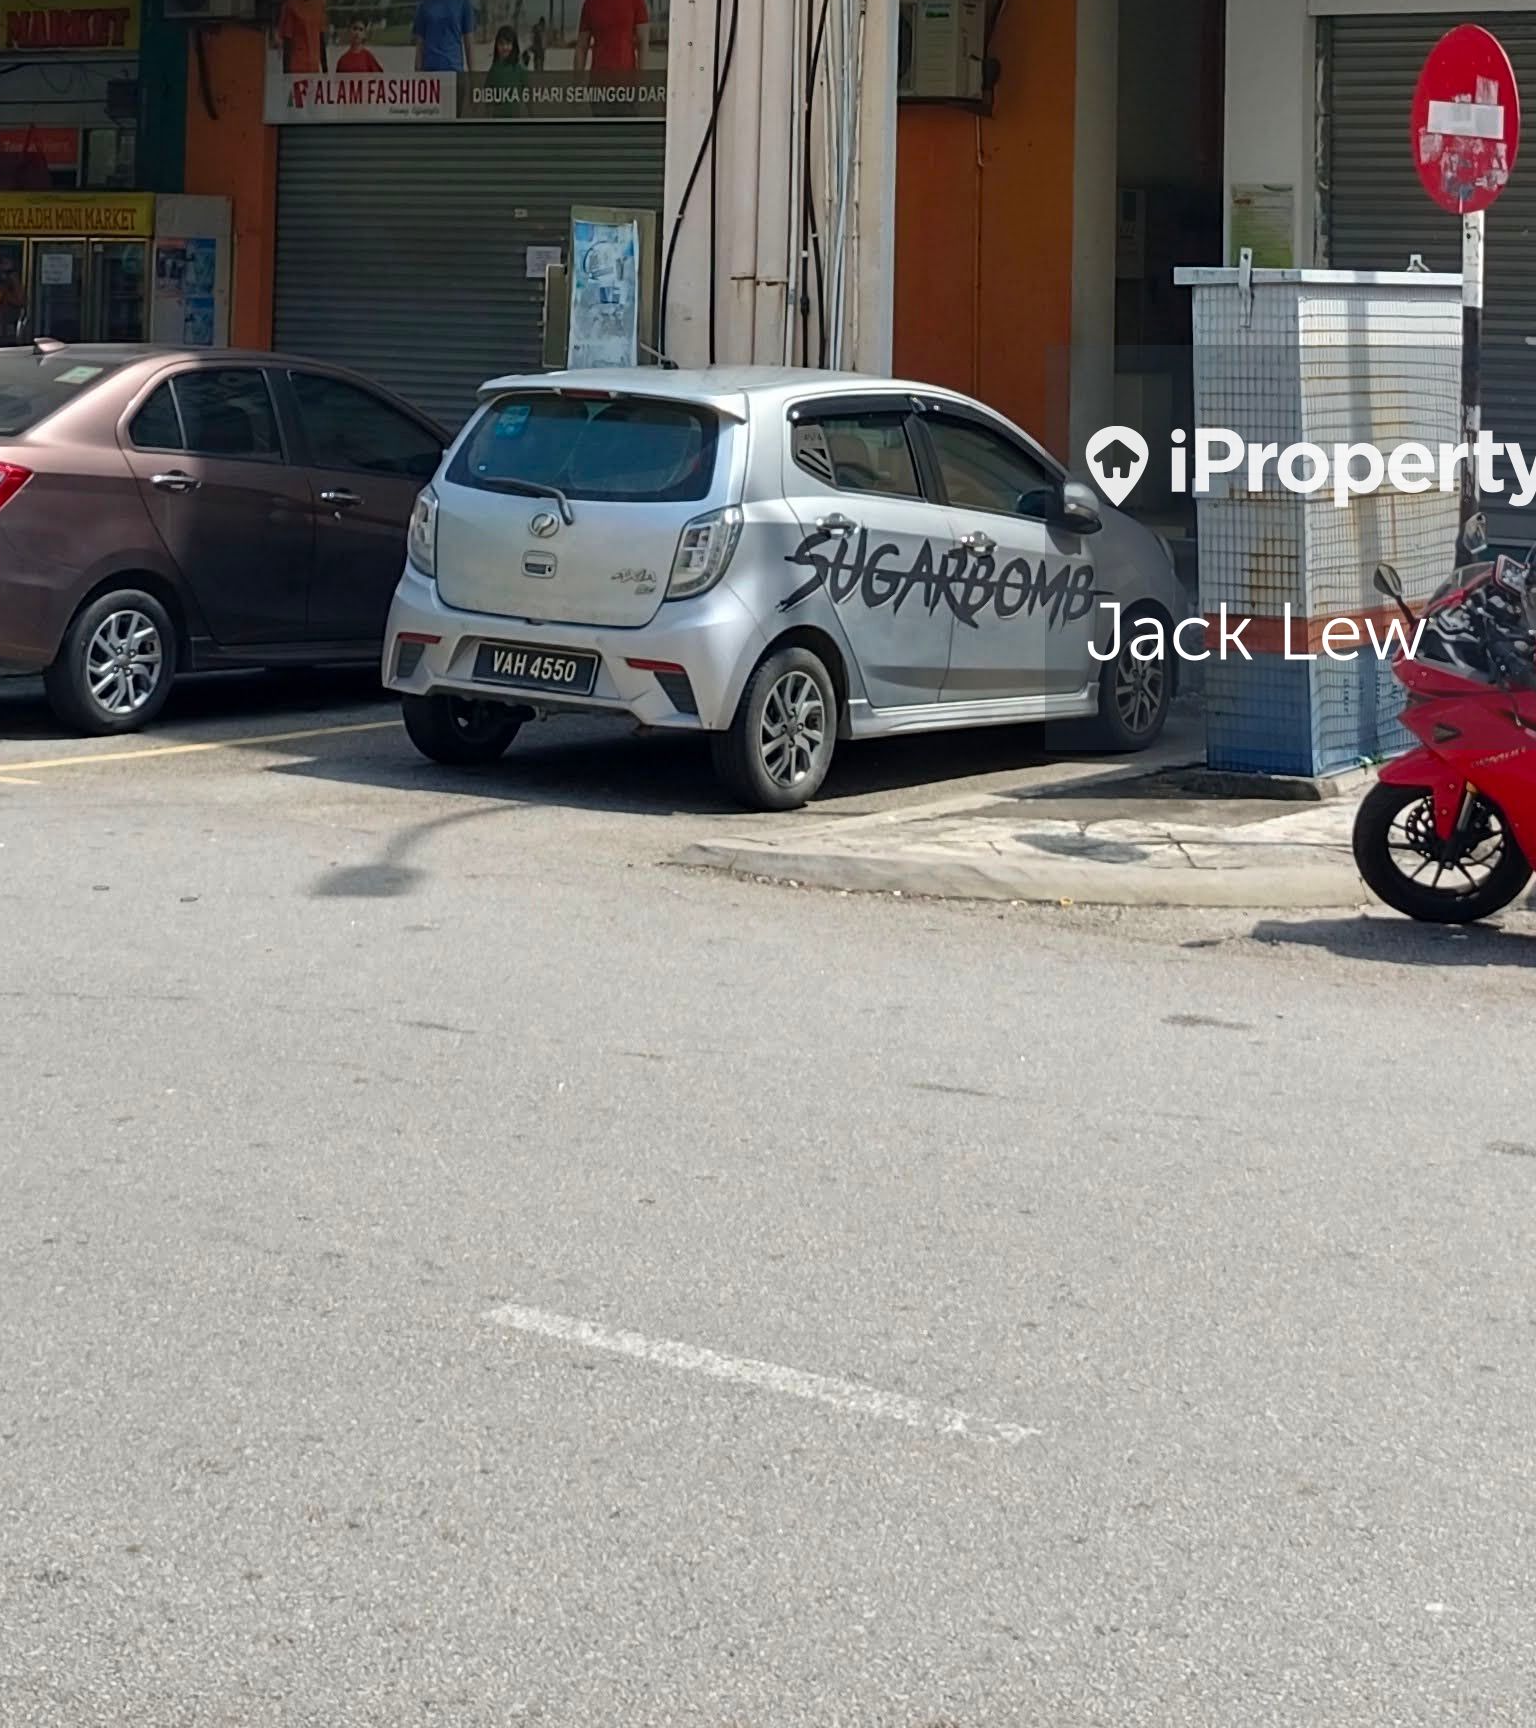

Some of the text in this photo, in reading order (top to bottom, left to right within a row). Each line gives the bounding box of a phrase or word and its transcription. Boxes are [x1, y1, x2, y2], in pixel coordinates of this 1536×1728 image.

[314, 79, 441, 105] ALAM FASHION
[472, 87, 520, 104] DIBUKA
[522, 87, 531, 102] 6
[532, 87, 564, 103] HARI
[565, 86, 636, 103] SEMINGGU
[55, 208, 84, 230] MINI
[85, 208, 137, 231] MARKET
[777, 524, 1114, 631] SUGARBOMB
[493, 650, 577, 683] VAH 4550
